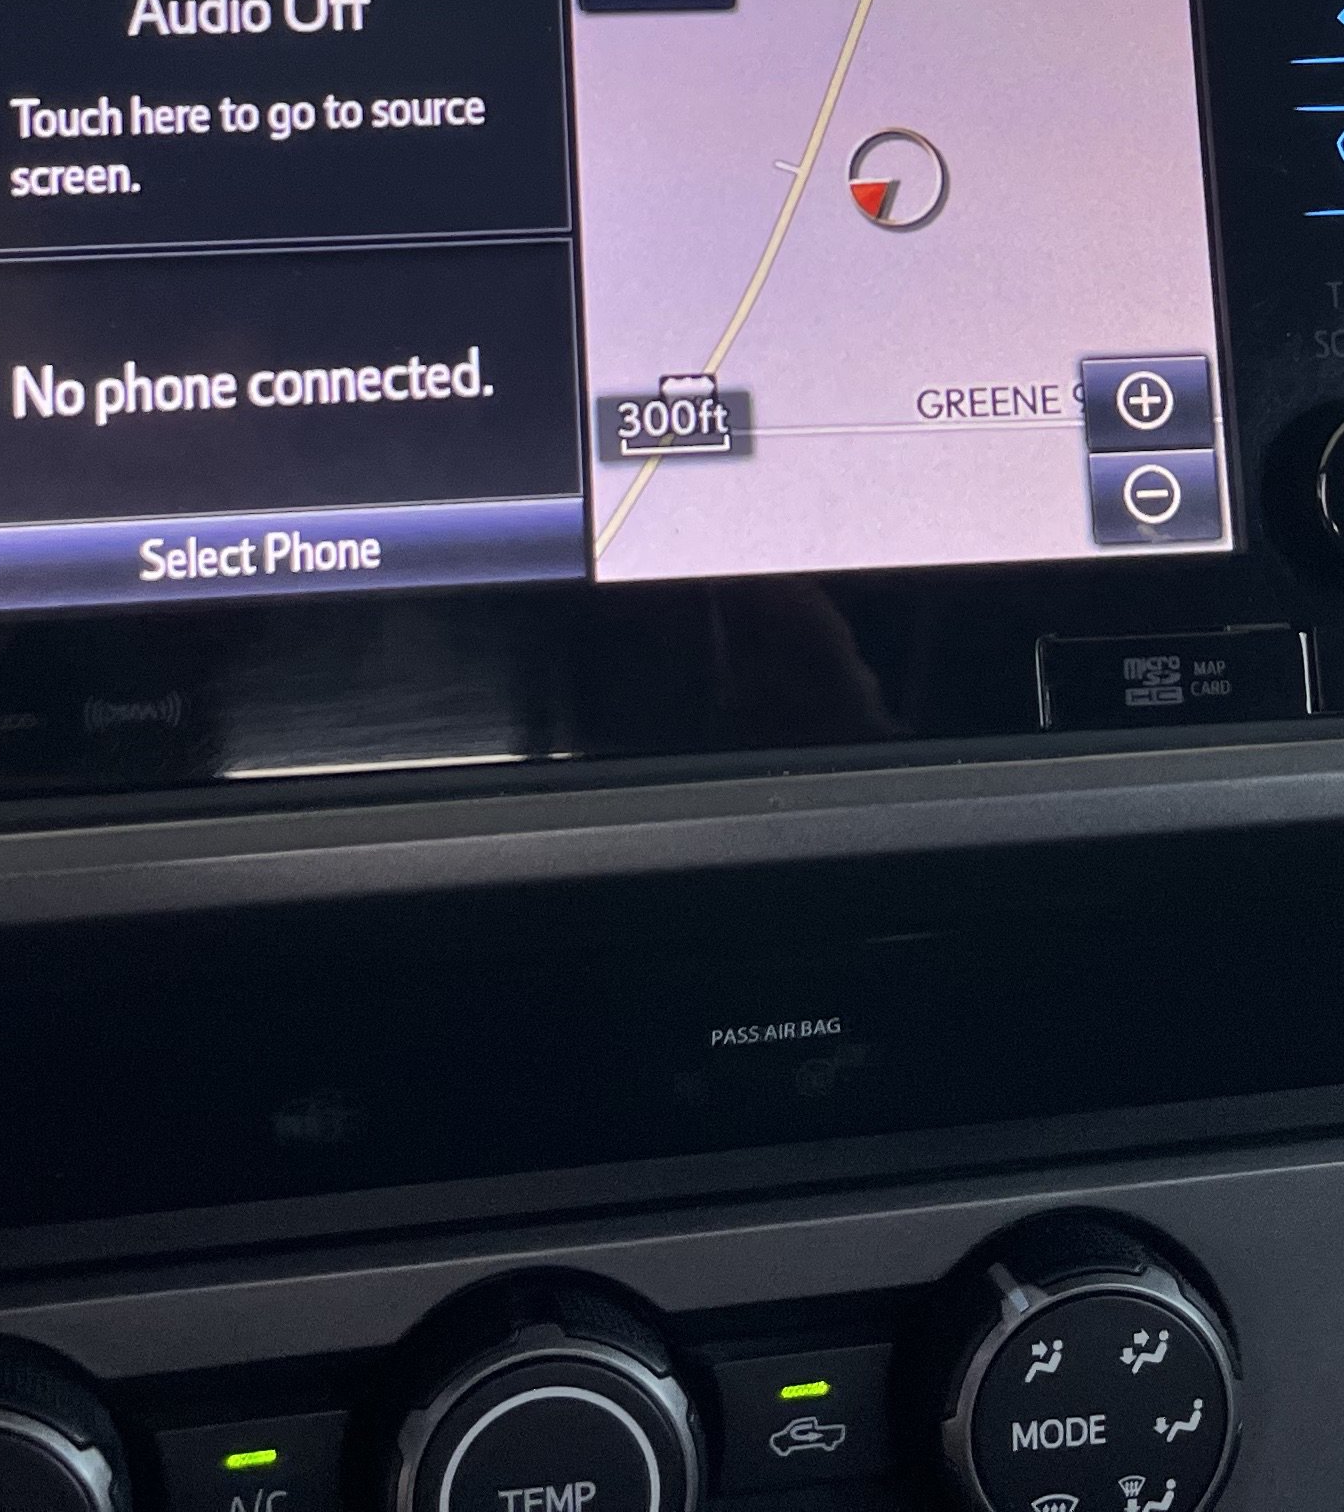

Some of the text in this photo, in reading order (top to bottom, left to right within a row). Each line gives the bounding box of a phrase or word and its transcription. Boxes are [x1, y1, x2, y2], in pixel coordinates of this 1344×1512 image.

[9, 93, 486, 142] Touch here to go to source
[10, 160, 141, 198] screen.
[11, 346, 494, 426] No phone connected.
[916, 384, 1062, 419] GREENE
[616, 398, 729, 439] 300ft
[139, 530, 382, 580] Select Phone
[1193, 660, 1227, 677] MAP
[1190, 679, 1232, 697] CARD
[711, 1016, 842, 1047] PASS AIR BAG
[1011, 1414, 1108, 1452] MODE
[497, 1481, 598, 1512] TEMP
